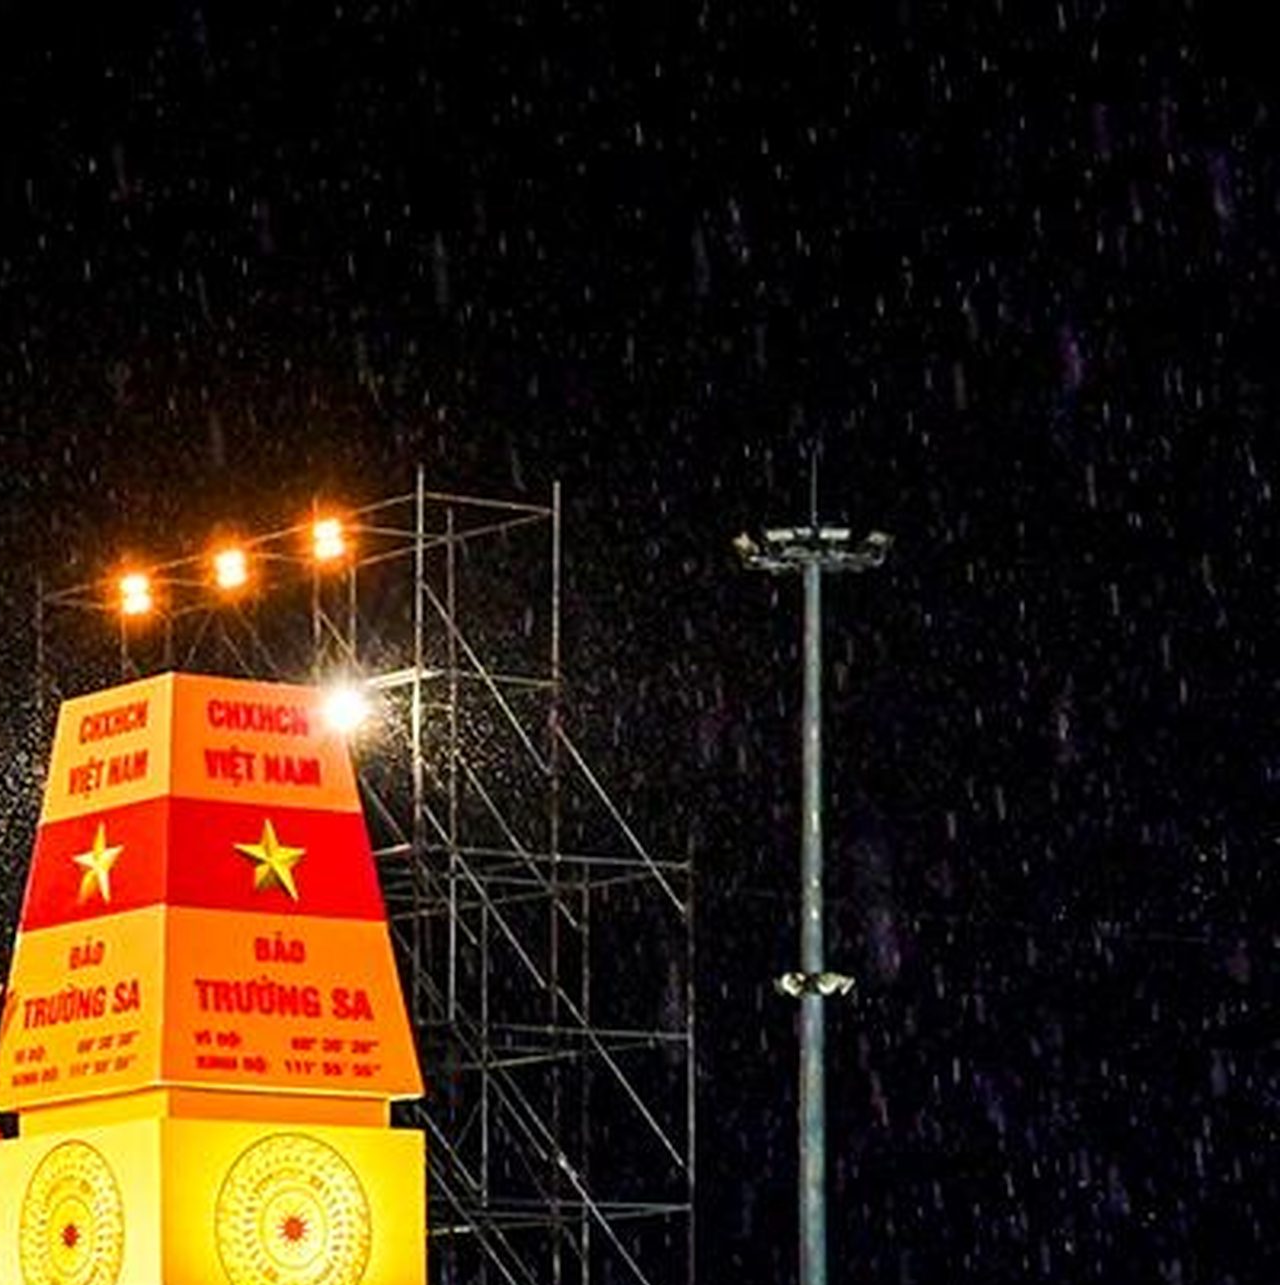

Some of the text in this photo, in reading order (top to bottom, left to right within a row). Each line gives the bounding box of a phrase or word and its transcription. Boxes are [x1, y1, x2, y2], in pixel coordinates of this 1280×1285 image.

[80, 701, 147, 744] CHXHCN
[207, 699, 309, 737] CHXHCN
[107, 749, 147, 787] NAM
[204, 746, 322, 787] VIỆT NAM
[24, 978, 140, 1029] TRƯỜNG SA
[194, 974, 375, 1021] TRƯỜNG SA
